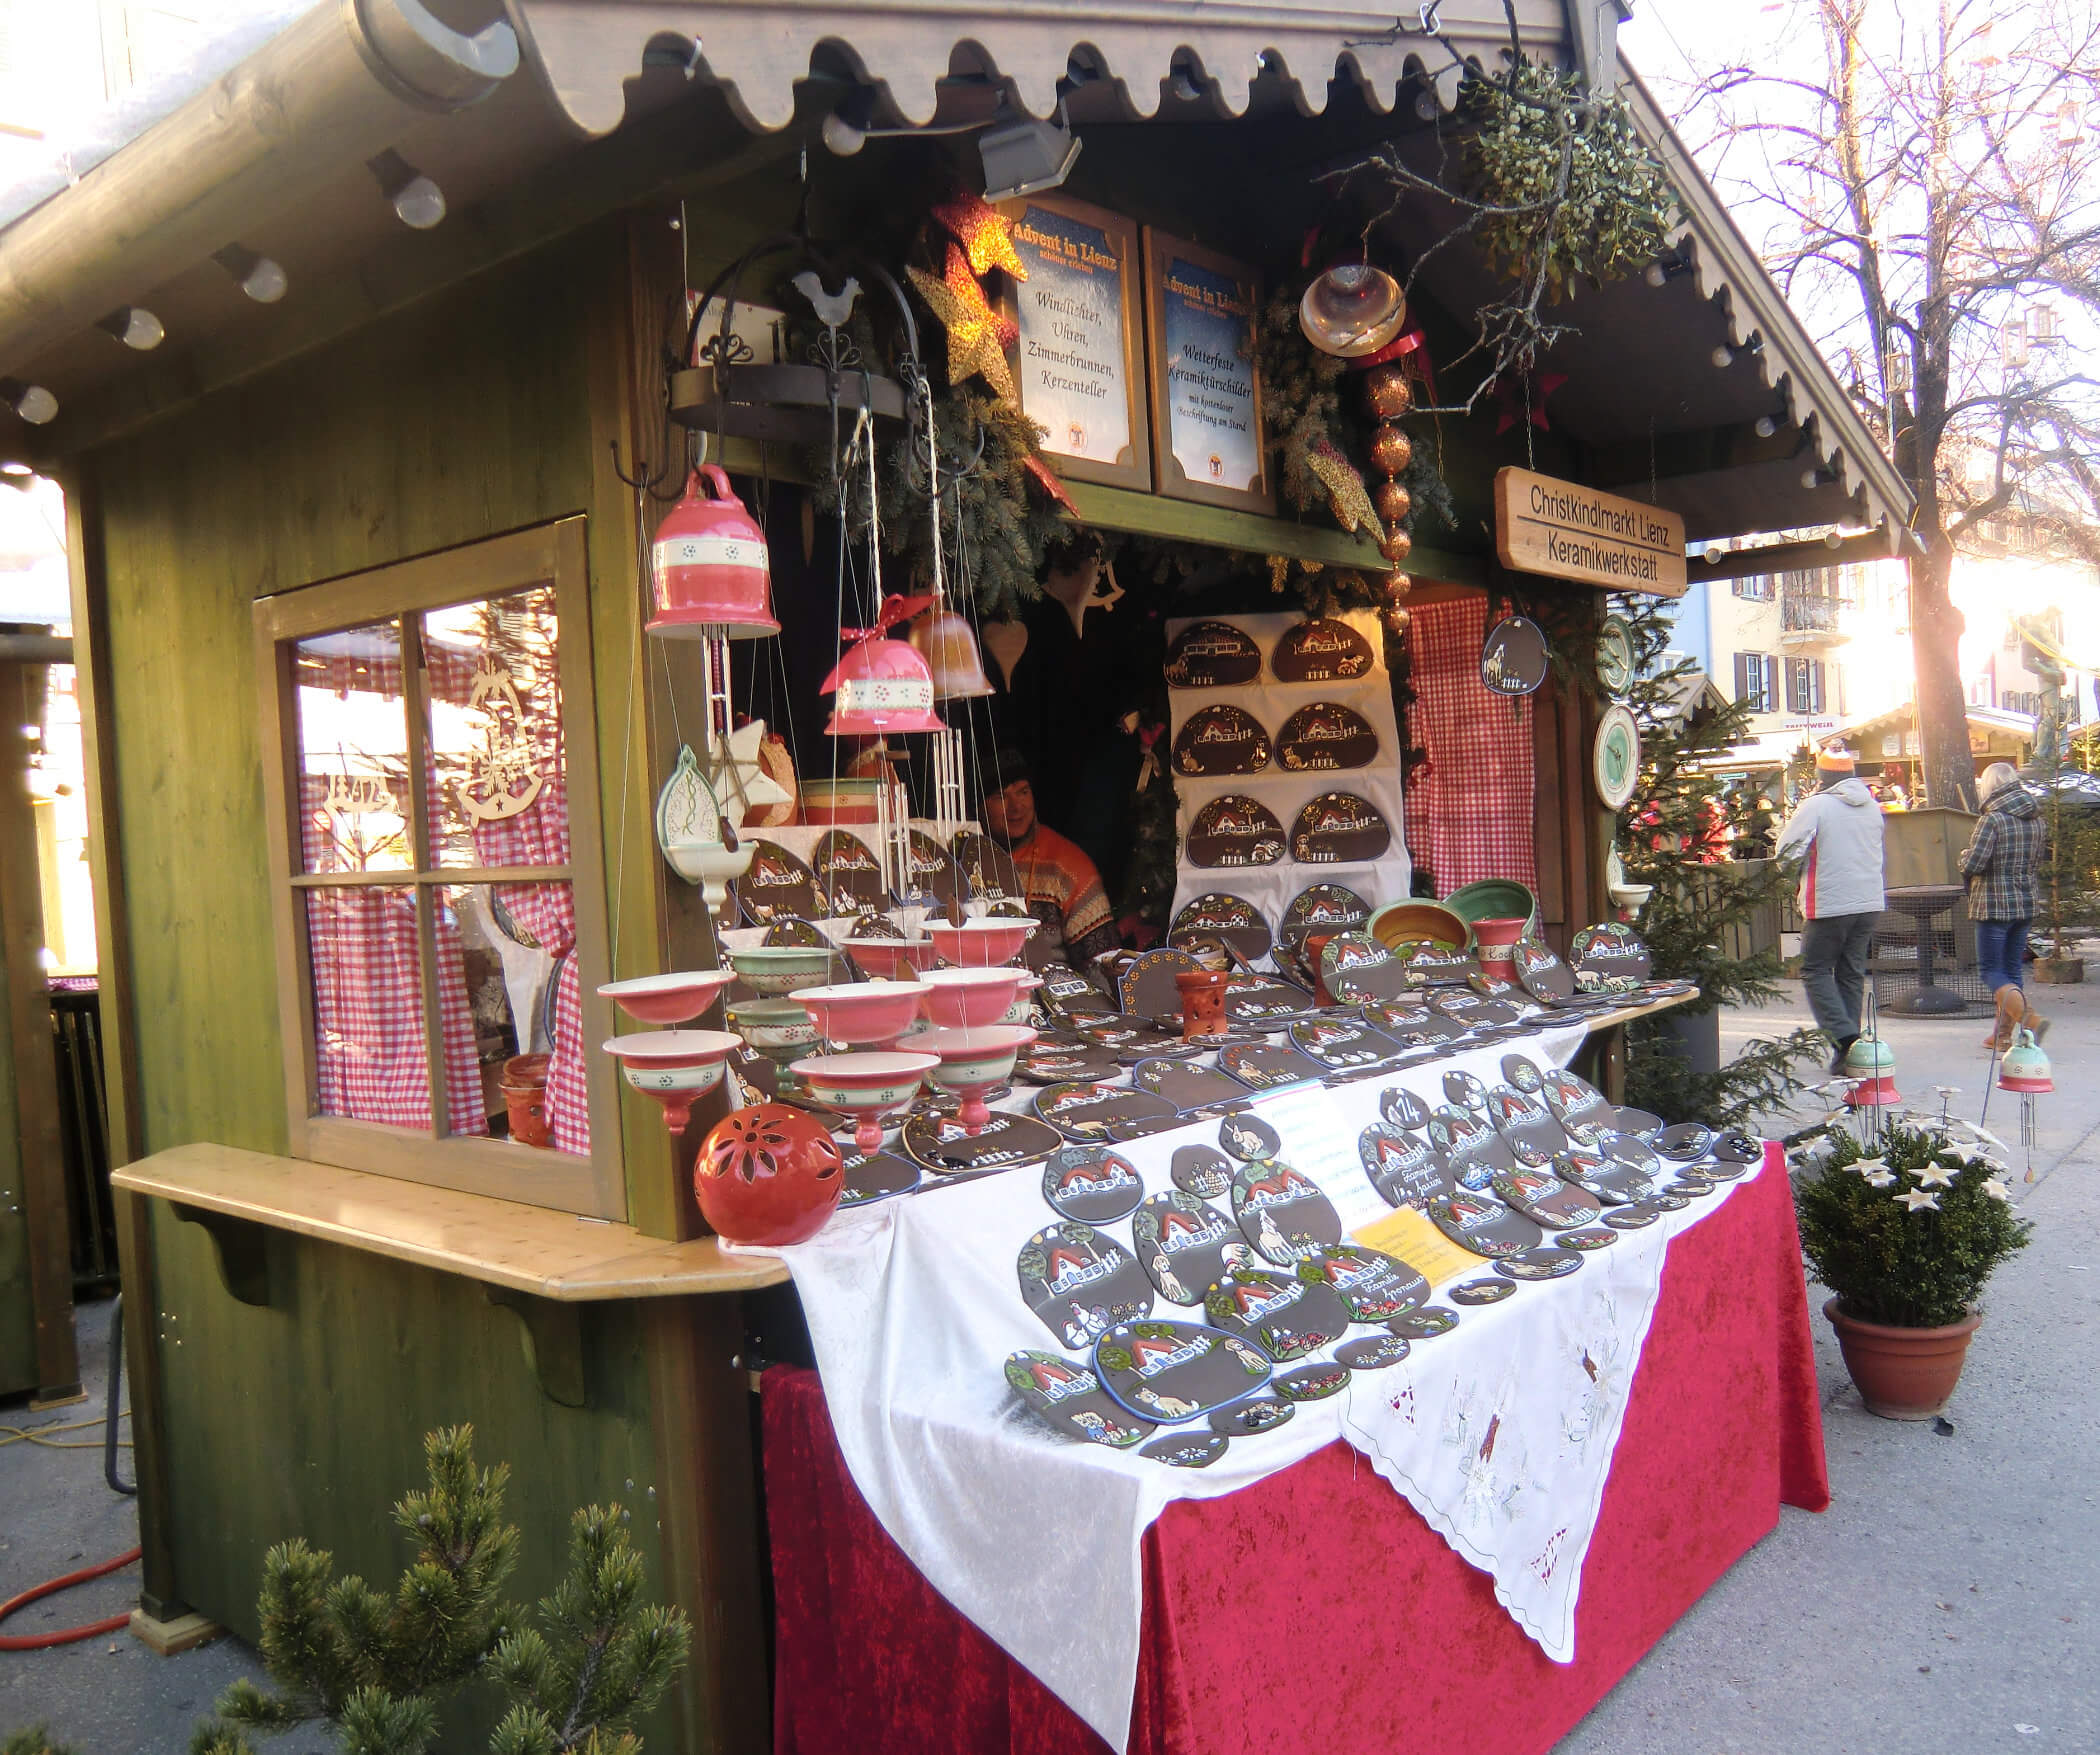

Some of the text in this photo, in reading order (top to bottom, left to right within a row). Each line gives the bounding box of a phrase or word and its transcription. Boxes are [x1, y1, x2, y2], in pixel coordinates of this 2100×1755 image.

[1014, 222, 1117, 272] Advent in Lienz
[1035, 291, 1102, 328] Windlichter,
[1203, 286, 1215, 305] in
[1052, 321, 1089, 347] Uhren,
[1028, 341, 1114, 379] Zimmerbrunnen,
[1183, 344, 1235, 372] Wetterfeste
[1041, 370, 1108, 399] Kerzenteller
[1169, 365, 1252, 398] Keramiktürschilder
[1189, 393, 1199, 405] mit
[1530, 484, 1670, 547] Christkindlmarkt Lienz
[1548, 530, 1658, 582] Keramikwerkstatt
[1361, 1272, 1400, 1293] Familie
